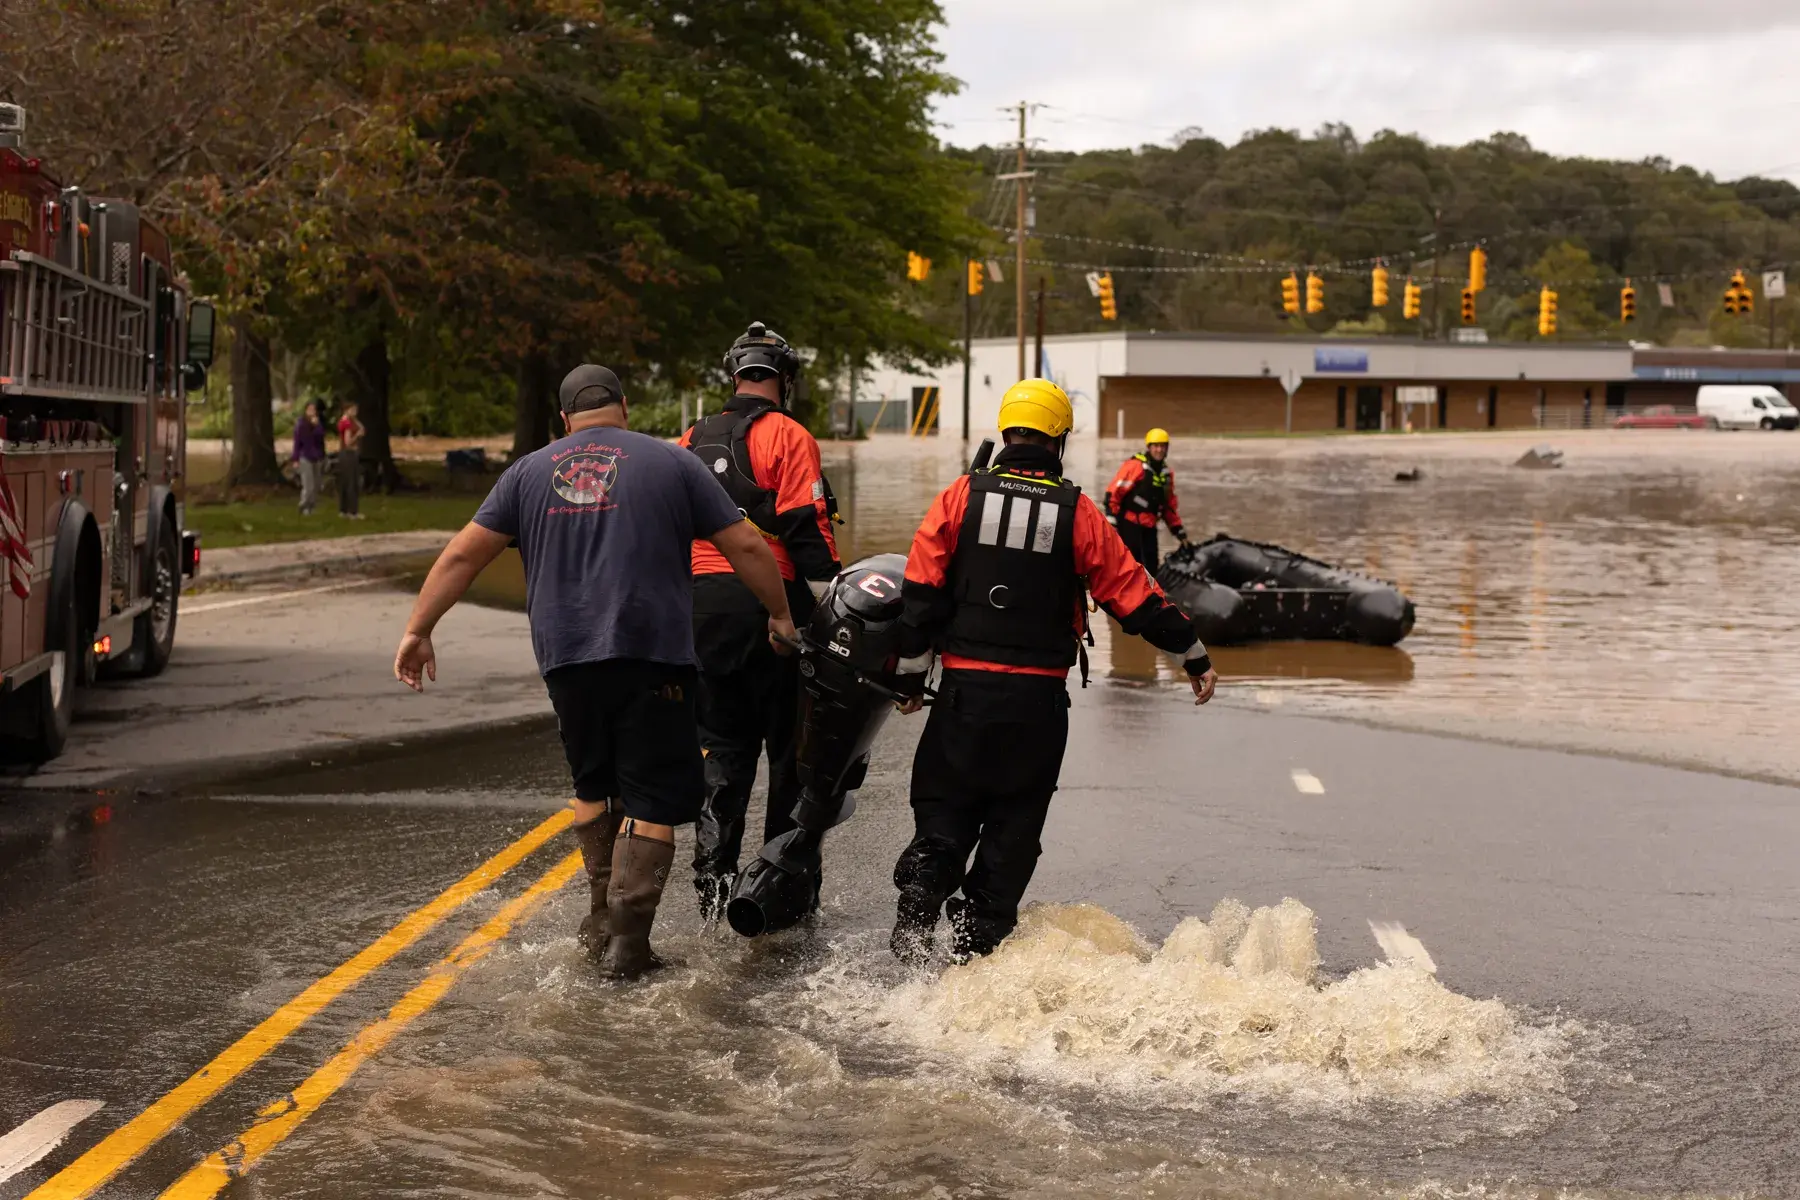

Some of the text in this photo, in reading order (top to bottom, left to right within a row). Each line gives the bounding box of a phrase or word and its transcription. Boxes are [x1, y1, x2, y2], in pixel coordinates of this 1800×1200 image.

[584, 443, 613, 452] Ladder
[999, 481, 1048, 495] MUSTANG
[559, 506, 584, 515] Original
[827, 640, 851, 658] 30
